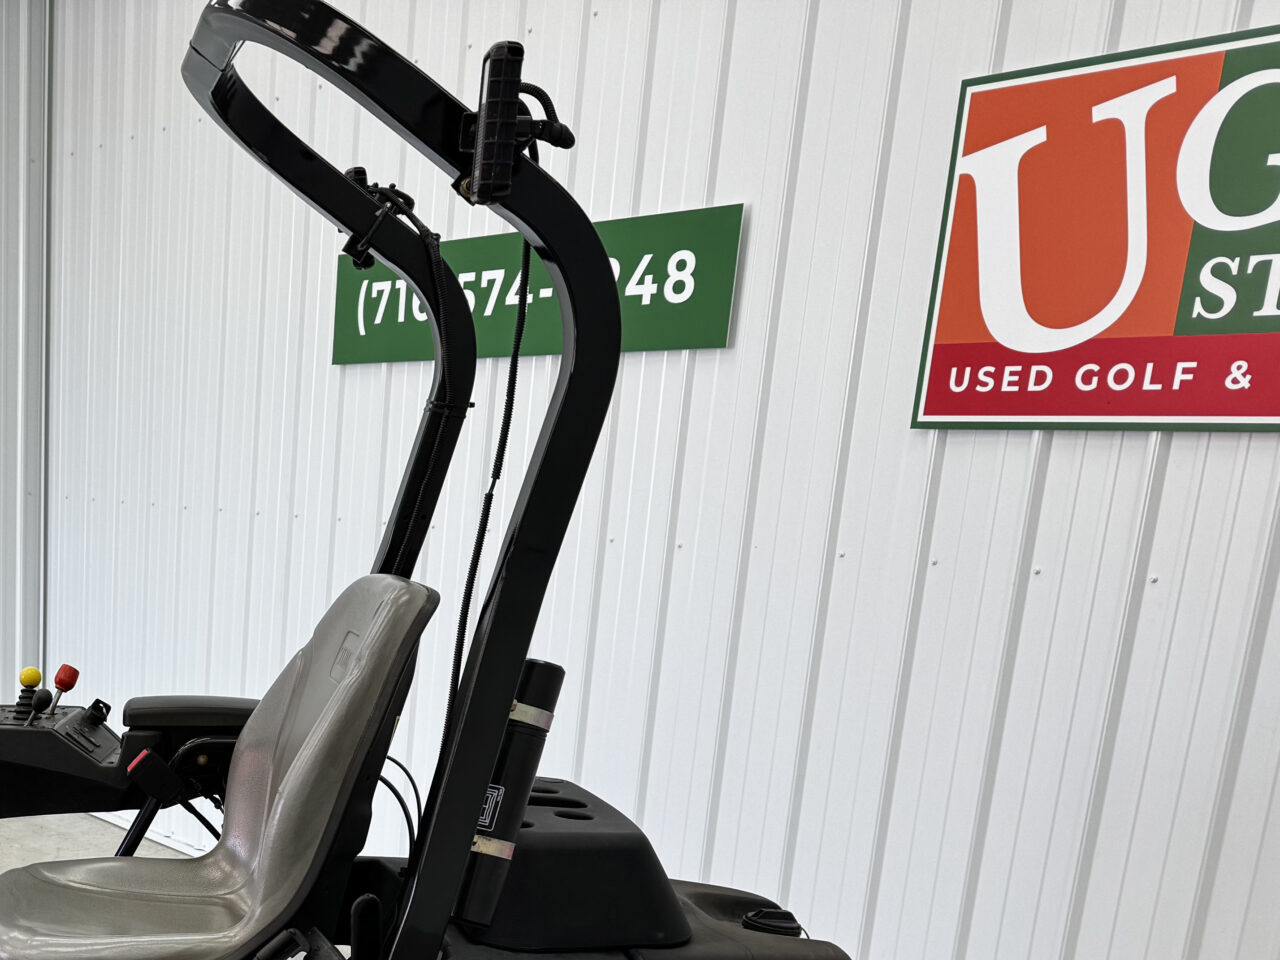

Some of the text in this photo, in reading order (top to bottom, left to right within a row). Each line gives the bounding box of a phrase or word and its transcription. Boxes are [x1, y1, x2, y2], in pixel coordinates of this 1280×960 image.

[357, 279, 429, 336] (71
[948, 359, 1252, 393] USED GOLF &
